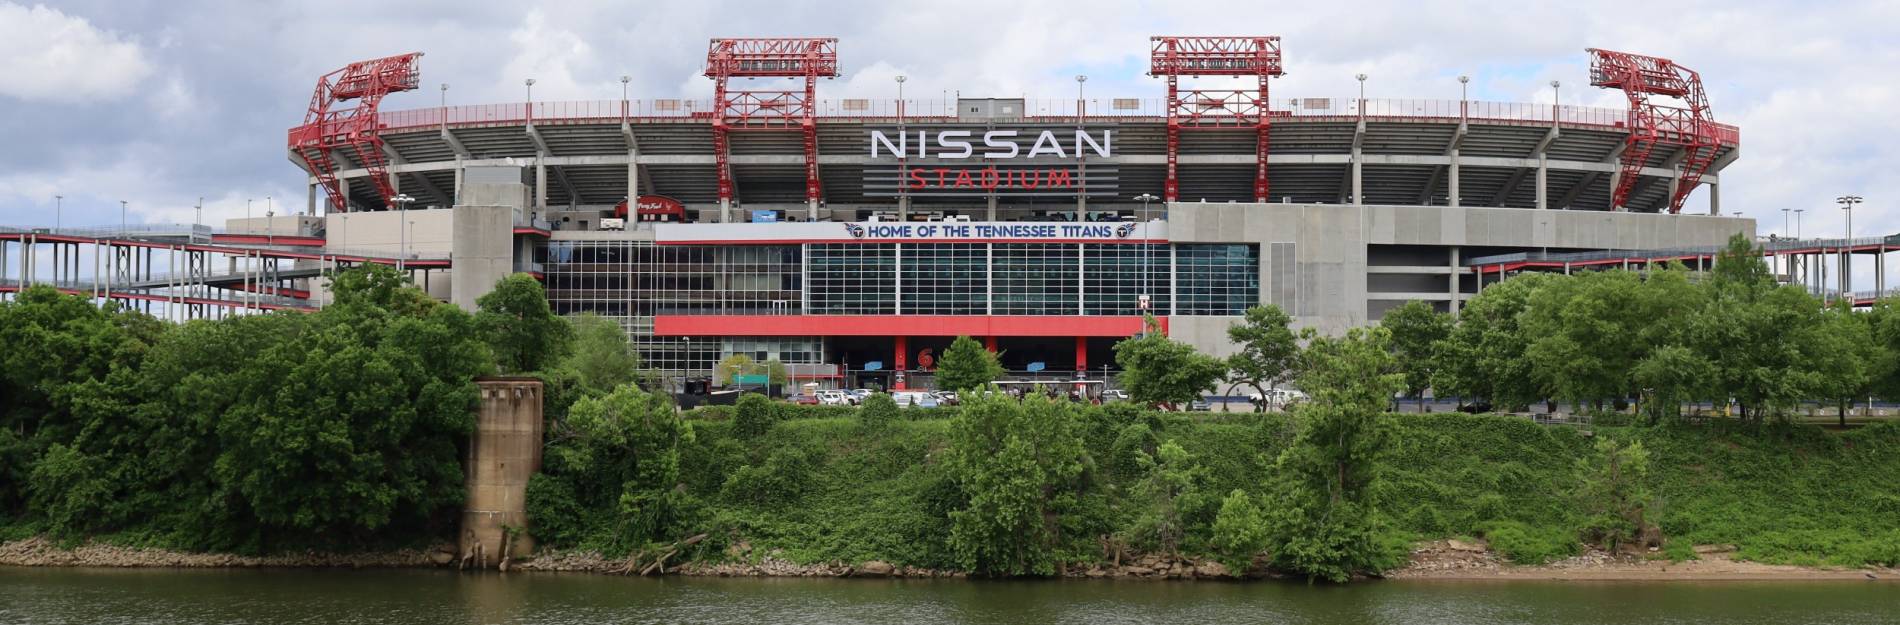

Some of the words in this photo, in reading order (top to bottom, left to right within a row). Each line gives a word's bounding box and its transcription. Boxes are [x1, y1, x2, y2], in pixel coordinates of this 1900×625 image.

[871, 129, 1111, 159] NISSAN
[911, 167, 1072, 190] STADIUM
[868, 225, 911, 238] HOME
[916, 225, 937, 238] OF
[943, 225, 970, 238] THE
[975, 225, 1056, 238] TENNESSEE
[1061, 225, 1112, 238] TITANS
[1140, 299, 1149, 309] H
[918, 347, 934, 367] 6
